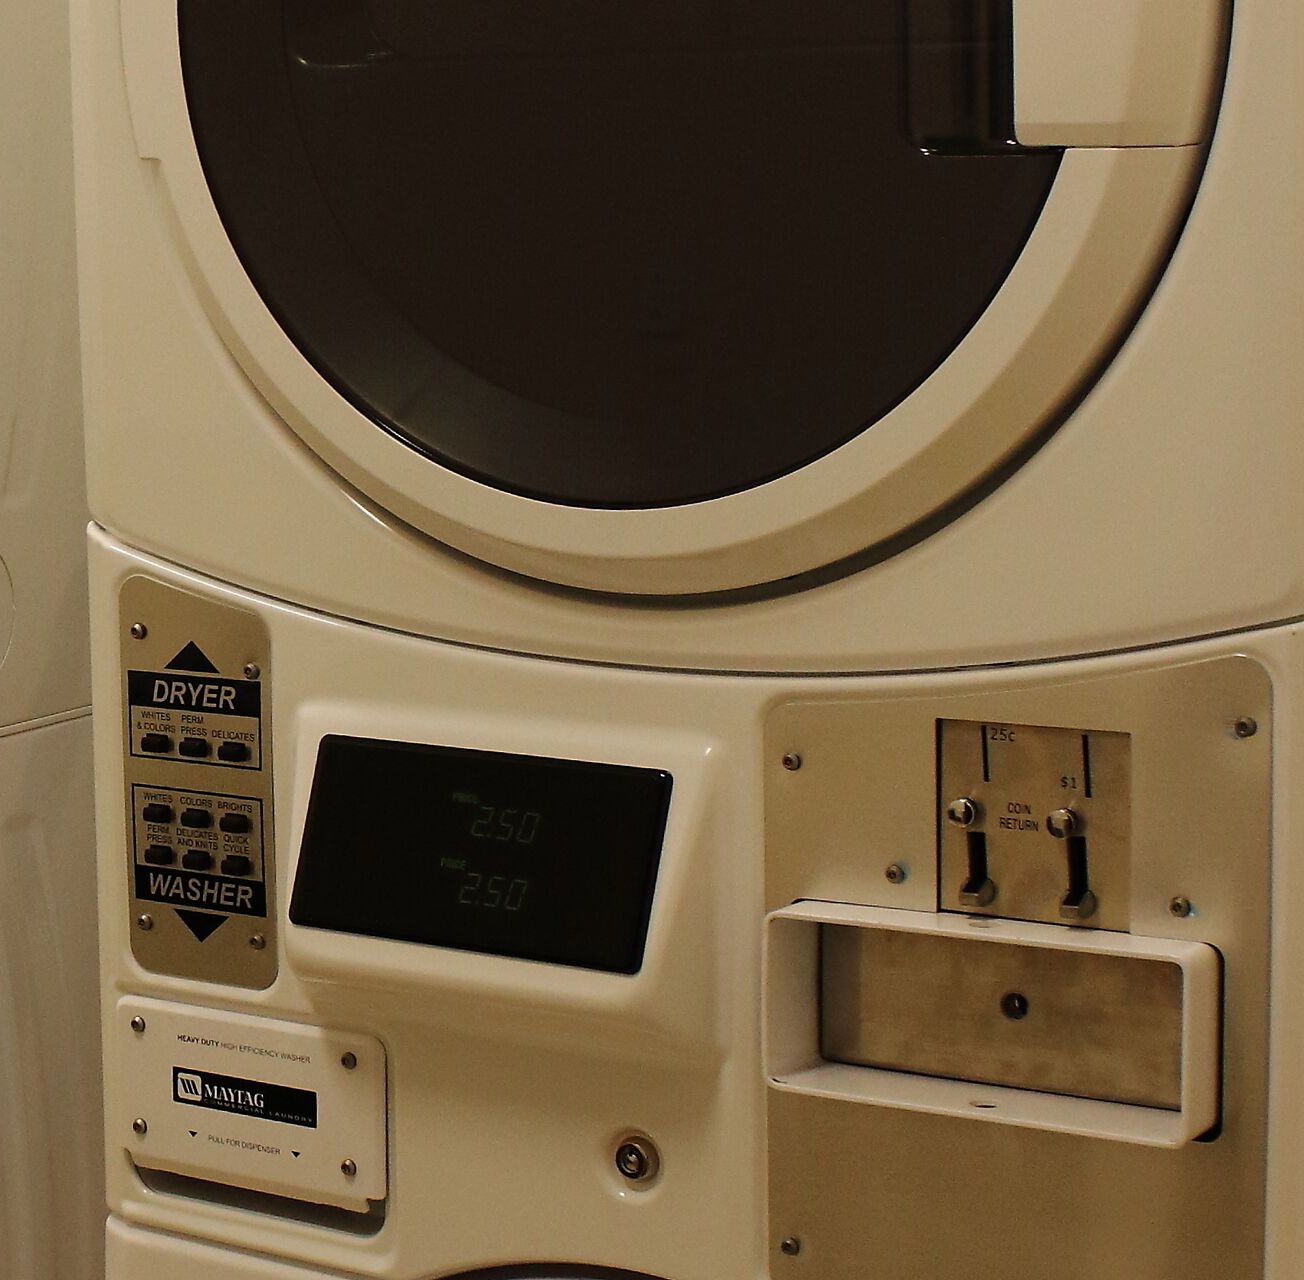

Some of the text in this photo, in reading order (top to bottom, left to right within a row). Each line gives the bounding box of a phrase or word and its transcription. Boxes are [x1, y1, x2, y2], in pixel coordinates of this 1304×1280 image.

[152, 679, 237, 710] DRYER
[141, 711, 171, 721] WHITES
[144, 722, 176, 734] COLORS
[180, 725, 208, 737] PRESS
[211, 729, 255, 742] DELICATES
[143, 792, 173, 804] WHITES
[179, 796, 213, 808] COLORS
[217, 801, 253, 813] BRIGHTS
[1007, 802, 1032, 814] COIN
[471, 806, 541, 844] 2.50
[999, 817, 1039, 832] RETURN
[146, 833, 173, 845] PRESS
[176, 827, 219, 841] DELICATES
[223, 834, 249, 845] QUICK
[177, 837, 219, 851] AND KNITS
[222, 843, 250, 855] CYCLE
[149, 872, 253, 909] WASHER
[458, 872, 528, 911] 2.50
[177, 1034, 200, 1045] HEAVY
[201, 1037, 219, 1048] DUTY
[239, 1045, 280, 1058] EFFICIENCY
[280, 1052, 311, 1064] WASHER
[204, 1083, 264, 1108] MAYTAG
[208, 1134, 281, 1155] PULL FOR DISPENSER
